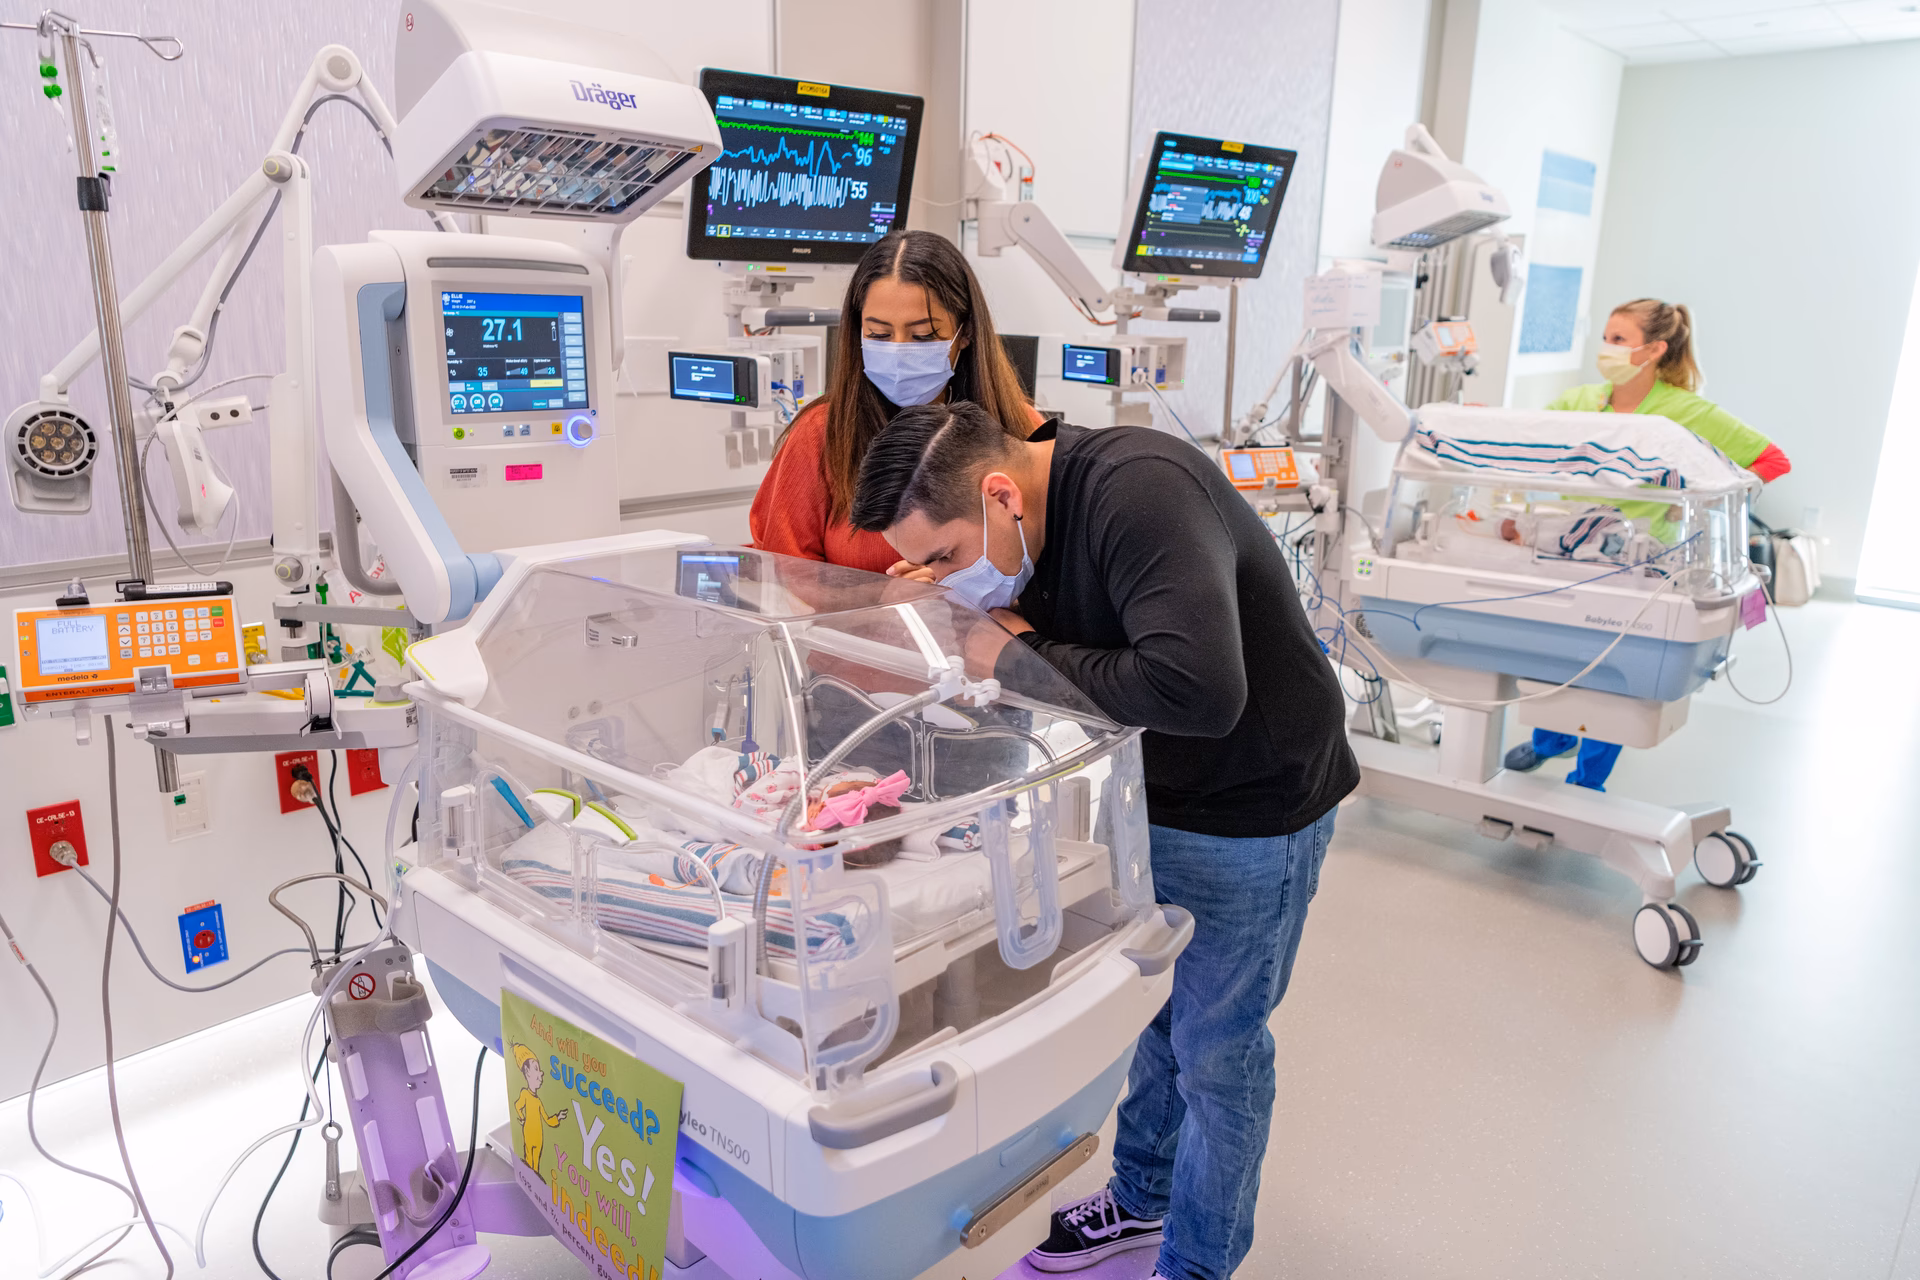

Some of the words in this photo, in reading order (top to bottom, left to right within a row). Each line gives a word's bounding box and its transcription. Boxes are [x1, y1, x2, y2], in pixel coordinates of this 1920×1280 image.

[569, 80, 637, 110] Dräger
[855, 147, 873, 166] 96
[850, 181, 868, 199] 55
[482, 318, 522, 342] 27.1
[477, 366, 488, 377] 35
[52, 625, 94, 635] BATTERY
[57, 620, 81, 628] FULL
[1585, 615, 1622, 627] Babyleo
[1624, 620, 1653, 631] T500
[45, 689, 87, 697] ENTERAL
[530, 1013, 553, 1048] And
[556, 1037, 579, 1061] will
[582, 1052, 607, 1078] you
[549, 1054, 660, 1146] succeed?
[680, 1109, 707, 1136] yleo
[709, 1125, 751, 1165] TN500
[571, 1098, 656, 1216] Yes!
[553, 1143, 591, 1198] You
[595, 1190, 638, 1248] will,
[534, 1191, 549, 1212] and
[561, 1222, 595, 1265] percent
